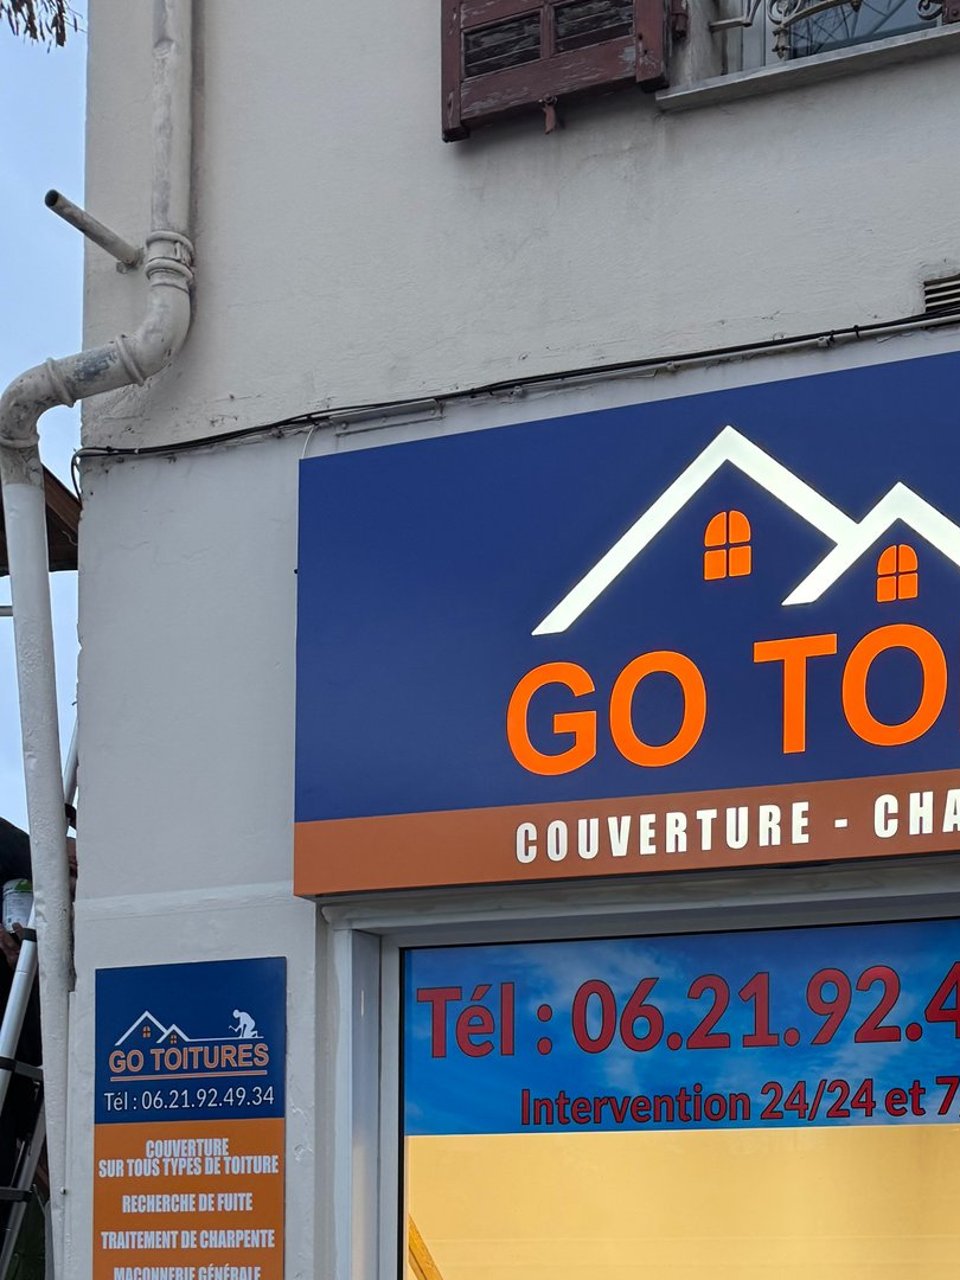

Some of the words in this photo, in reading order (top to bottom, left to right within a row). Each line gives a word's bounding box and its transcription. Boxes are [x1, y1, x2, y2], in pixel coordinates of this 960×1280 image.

[506, 651, 707, 776] GO
[515, 801, 810, 863] COUVERTURE
[416, 981, 516, 1059] Tél
[109, 1049, 144, 1073] GO
[151, 1043, 269, 1071] TOITURES
[104, 1092, 128, 1111] Tél
[141, 1086, 274, 1109] 06.21.92.49.34
[520, 1083, 752, 1127] Intervention
[760, 1077, 876, 1123] 24/24
[884, 1083, 926, 1118] et
[146, 1138, 229, 1158] COUVERTURE
[99, 1159, 124, 1177] SUR
[127, 1158, 160, 1177] TOUS
[163, 1157, 201, 1176] TYPES
[204, 1156, 221, 1175] DE
[224, 1155, 279, 1174] TOITURE
[122, 1194, 196, 1213] RECHERCHE
[200, 1194, 215, 1212] DE
[217, 1193, 253, 1211] FUITE
[101, 1231, 178, 1249] TRAITEMENT
[182, 1231, 197, 1249] DE
[200, 1230, 275, 1248] CHARPENTE
